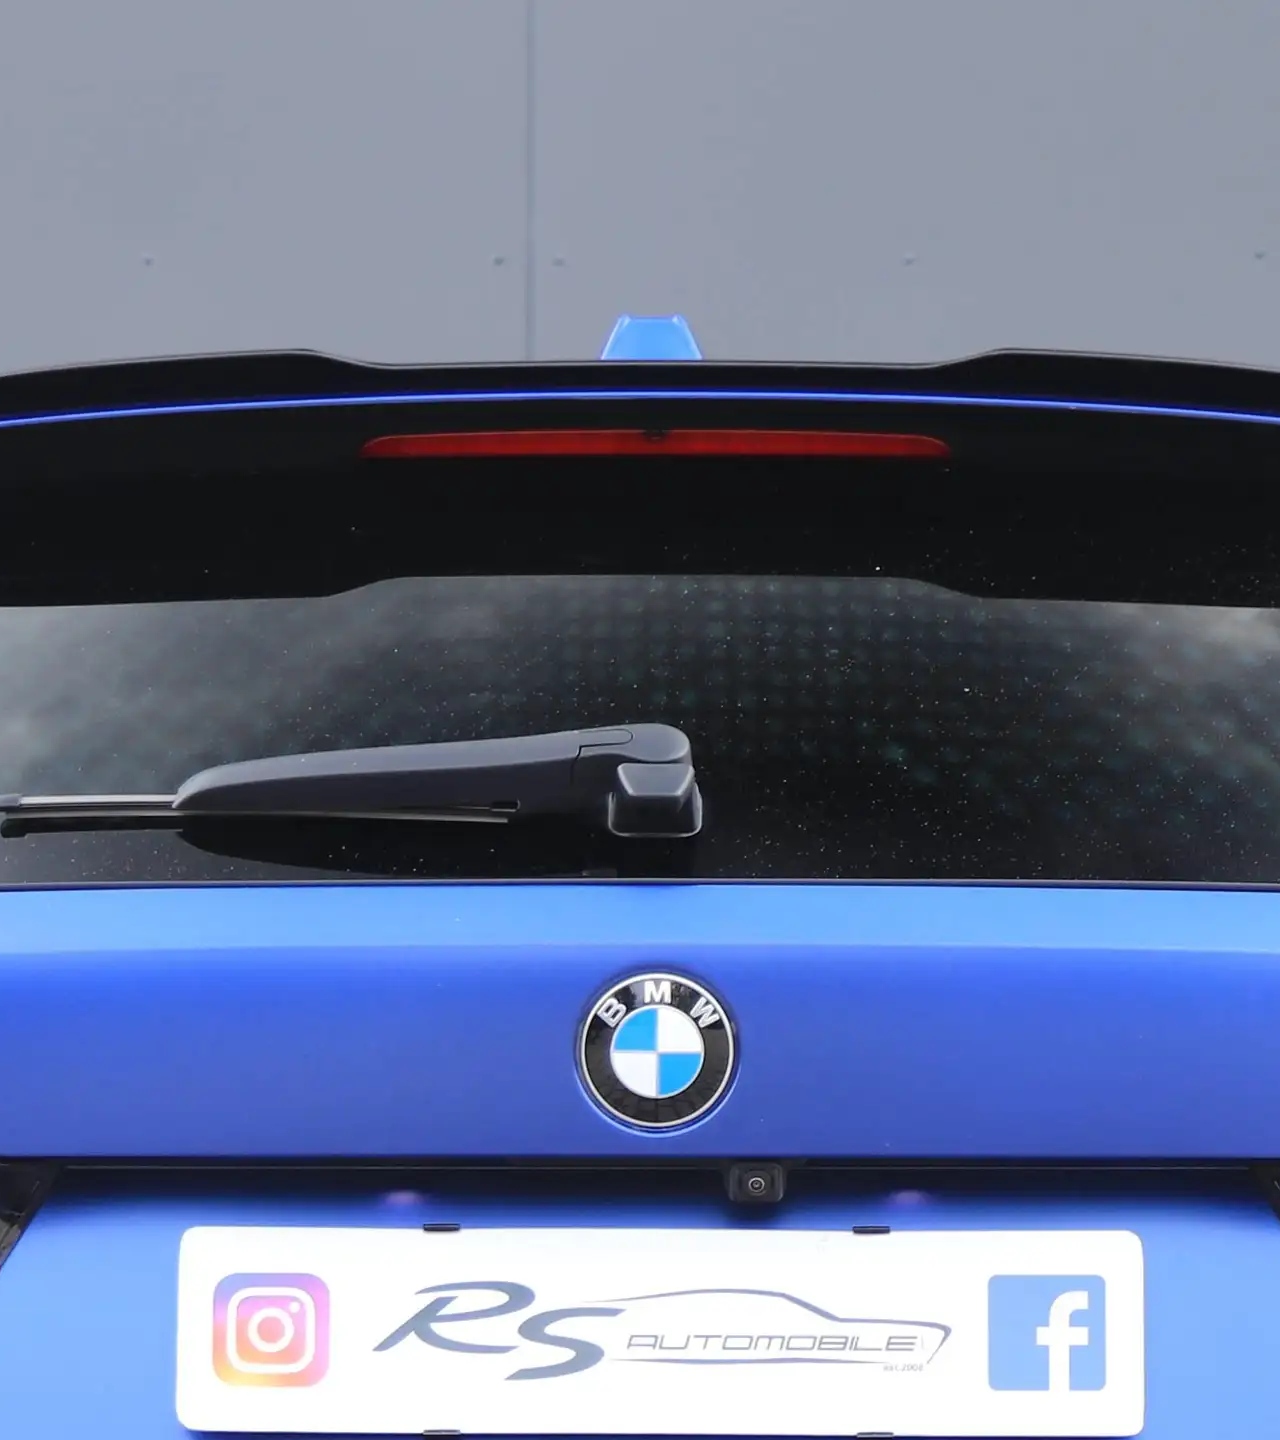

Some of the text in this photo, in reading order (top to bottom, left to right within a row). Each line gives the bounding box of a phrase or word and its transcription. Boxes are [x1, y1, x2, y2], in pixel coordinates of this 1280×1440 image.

[597, 980, 720, 1028] BMW
[372, 1281, 918, 1381] RS AUTOMOBILE
